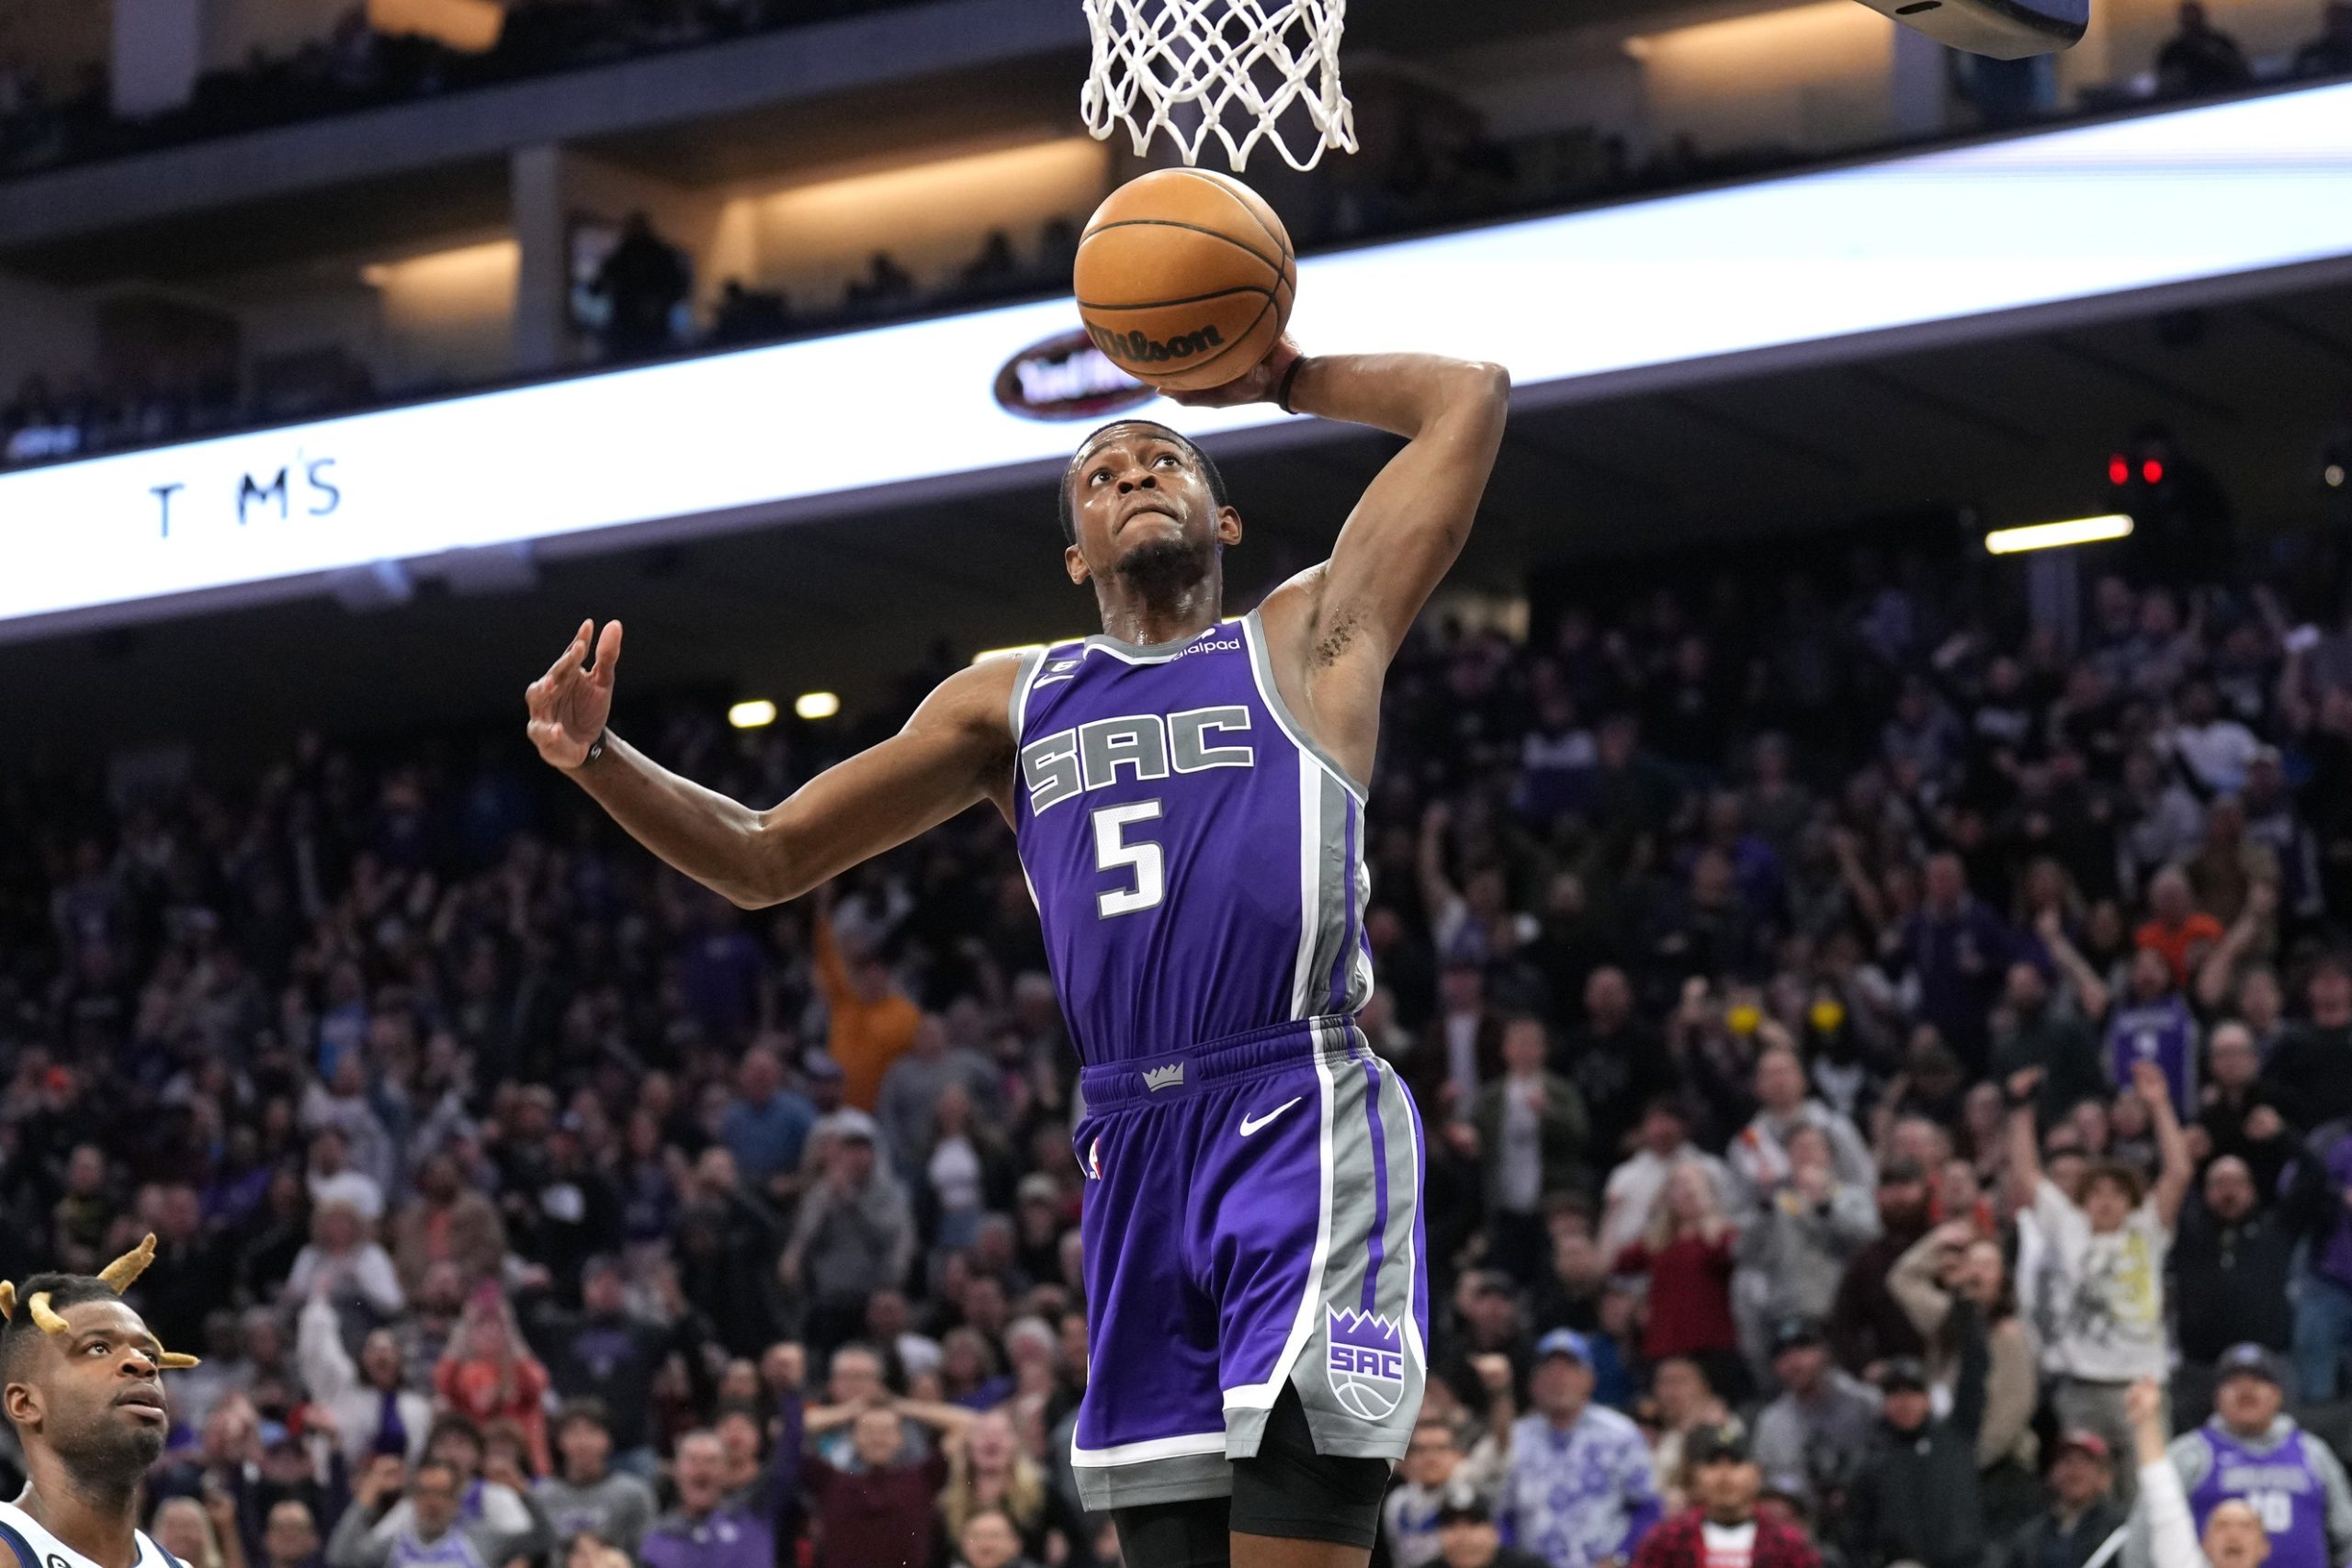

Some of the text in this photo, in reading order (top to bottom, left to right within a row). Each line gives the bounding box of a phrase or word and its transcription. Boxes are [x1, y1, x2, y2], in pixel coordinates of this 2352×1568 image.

[1084, 319, 1225, 363] Wilson
[1021, 705, 1254, 818] SAC
[1090, 797, 1166, 920] 5
[1329, 1345, 1403, 1381] SAC
